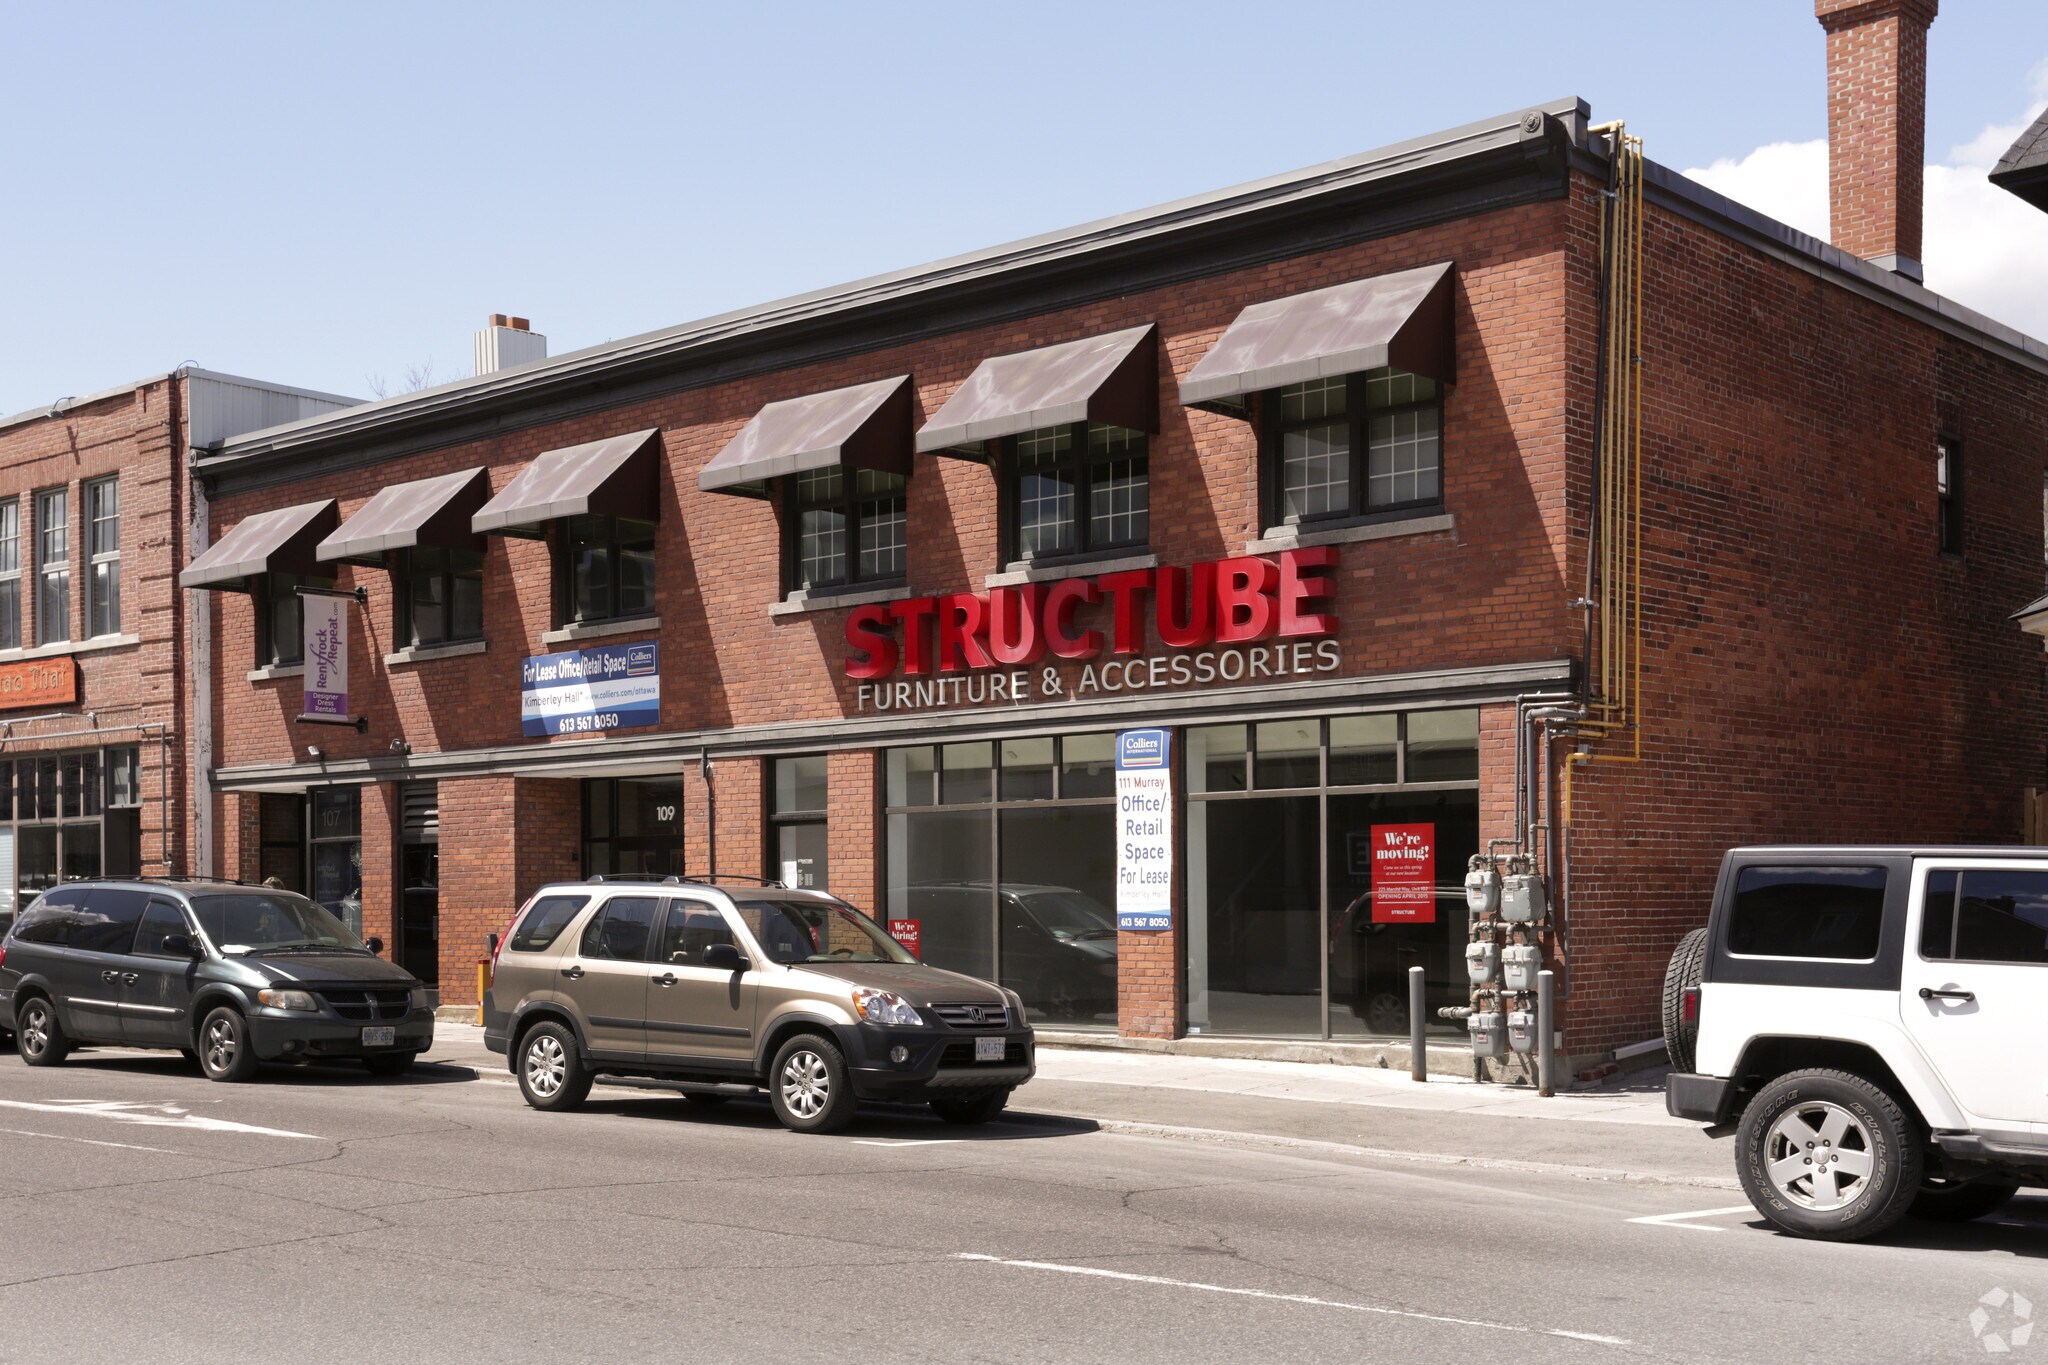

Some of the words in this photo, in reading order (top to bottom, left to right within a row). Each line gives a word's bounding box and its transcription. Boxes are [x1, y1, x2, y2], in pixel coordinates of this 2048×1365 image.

[844, 546, 1340, 680] STRUCTUBE
[630, 651, 652, 662] Colliers
[524, 664, 535, 683] For
[536, 663, 557, 681] Lease
[603, 653, 627, 677] Space
[857, 670, 1030, 711] FURNITURE
[1041, 666, 1064, 696] &
[1078, 639, 1340, 693] ACCESSORIES
[29, 662, 66, 691] Thai
[313, 692, 339, 700] Designer
[317, 699, 334, 707] Dress
[525, 696, 562, 707] Kimberley
[315, 705, 337, 713] Rentals
[560, 718, 575, 732] 613
[577, 716, 592, 730] 567
[594, 713, 619, 728] 8050
[1126, 737, 1158, 749] Colliers
[1119, 777, 1131, 789] 111
[1134, 776, 1165, 790] Murray
[1121, 792, 1167, 813] Office/
[321, 810, 341, 827] 107
[656, 805, 675, 822] 109
[1126, 818, 1163, 836] Retail
[1384, 832, 1421, 846] We're
[1125, 843, 1164, 864] Space
[1376, 845, 1430, 861] moving!
[1120, 867, 1136, 884] For
[1140, 867, 1168, 884] Lease
[894, 921, 915, 931] We're
[1121, 917, 1132, 927] 613
[1134, 917, 1147, 927] 567
[1149, 917, 1169, 927] 8050
